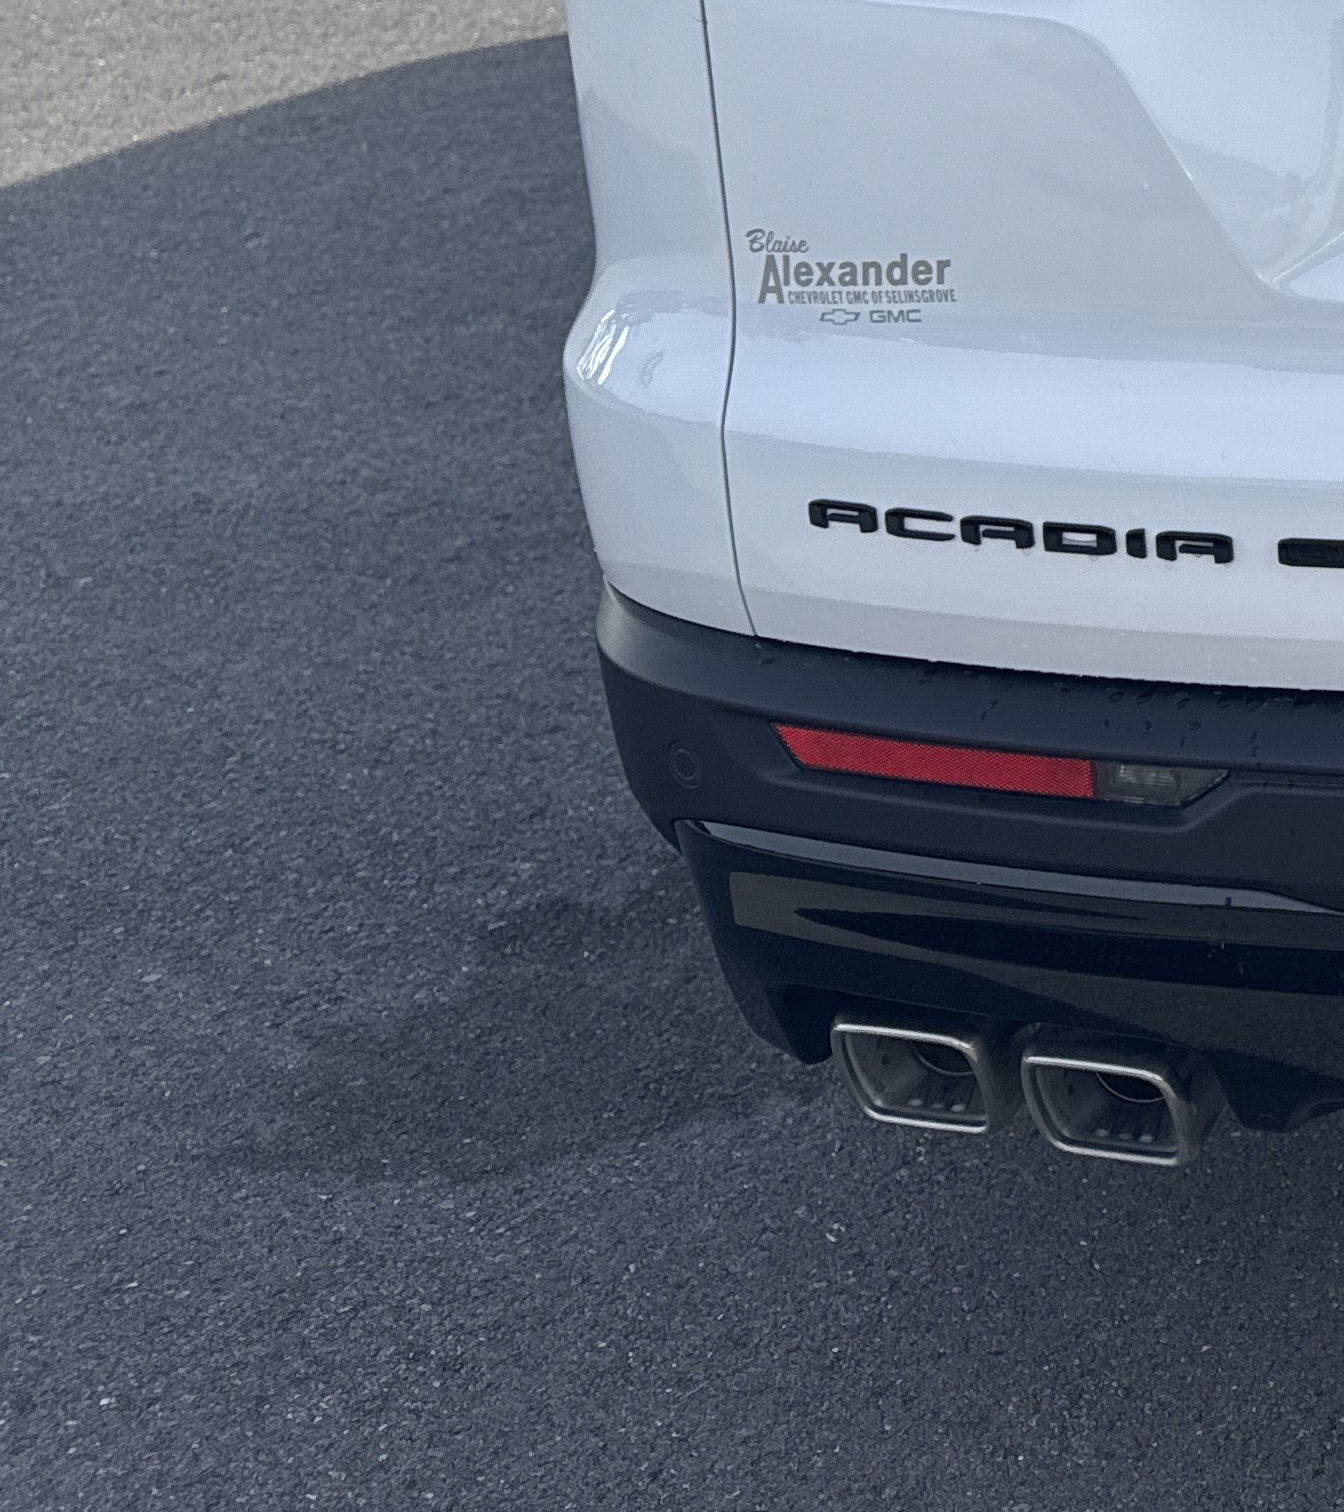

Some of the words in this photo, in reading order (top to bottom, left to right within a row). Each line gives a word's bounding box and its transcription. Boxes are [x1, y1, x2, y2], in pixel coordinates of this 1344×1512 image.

[746, 228, 809, 254] Blaise
[758, 253, 952, 304] Alexander
[788, 291, 843, 304] CHEVROLET
[846, 290, 869, 304] GMC
[872, 290, 883, 304] OF
[885, 289, 957, 304] SELINSGROVE
[869, 309, 922, 323] GMC
[808, 498, 1234, 564] ACADIA
